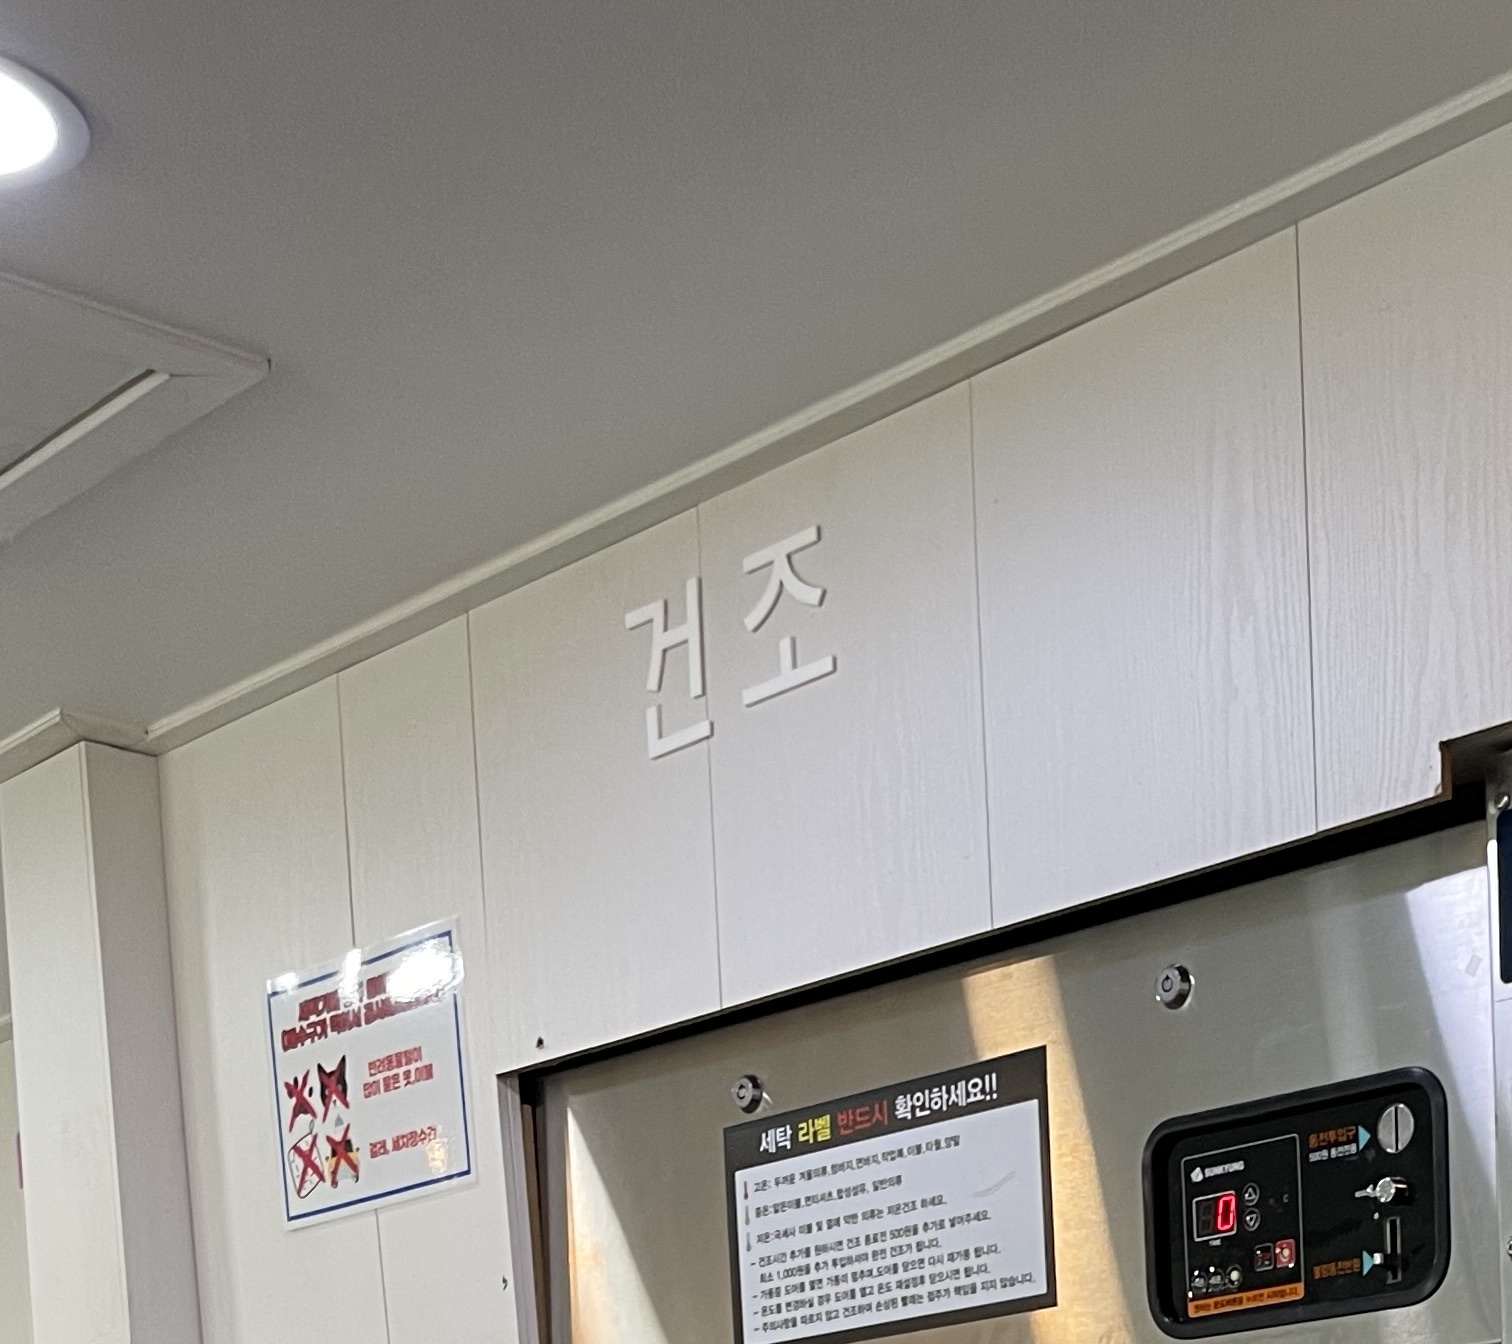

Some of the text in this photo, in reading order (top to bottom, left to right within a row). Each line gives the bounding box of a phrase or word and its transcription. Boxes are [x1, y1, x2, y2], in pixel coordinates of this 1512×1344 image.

[760, 1073, 997, 1153] 세탁 라벨 반드시 확인하세요!!
[1217, 1194, 1236, 1231] 0
[847, 1237, 861, 1249] 건조
[928, 1254, 944, 1266] 다시
[974, 1243, 1001, 1258] 됩니다.
[814, 1261, 828, 1273] 추가
[878, 1282, 893, 1294] 온도
[964, 1263, 990, 1278] 됩니다.
